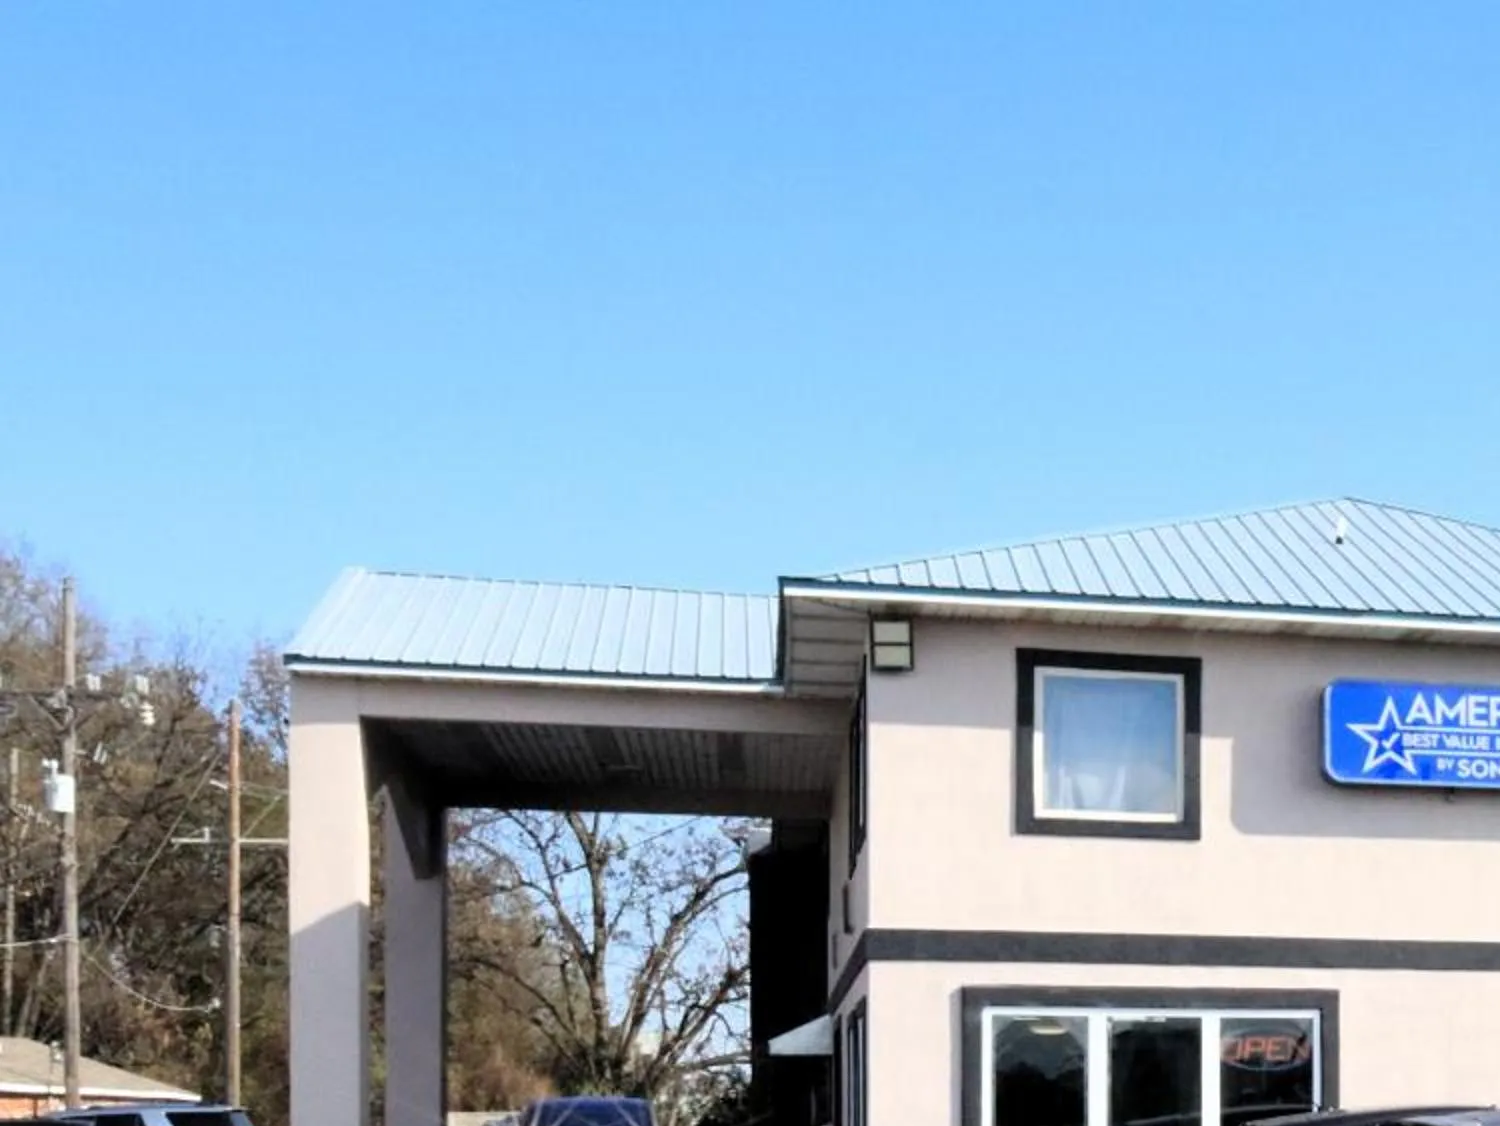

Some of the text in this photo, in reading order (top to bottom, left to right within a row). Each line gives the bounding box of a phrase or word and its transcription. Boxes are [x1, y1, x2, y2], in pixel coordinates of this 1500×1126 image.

[1402, 733, 1440, 749] BEST
[1441, 733, 1490, 751] VALUE
[1220, 1036, 1310, 1061] OPEN
